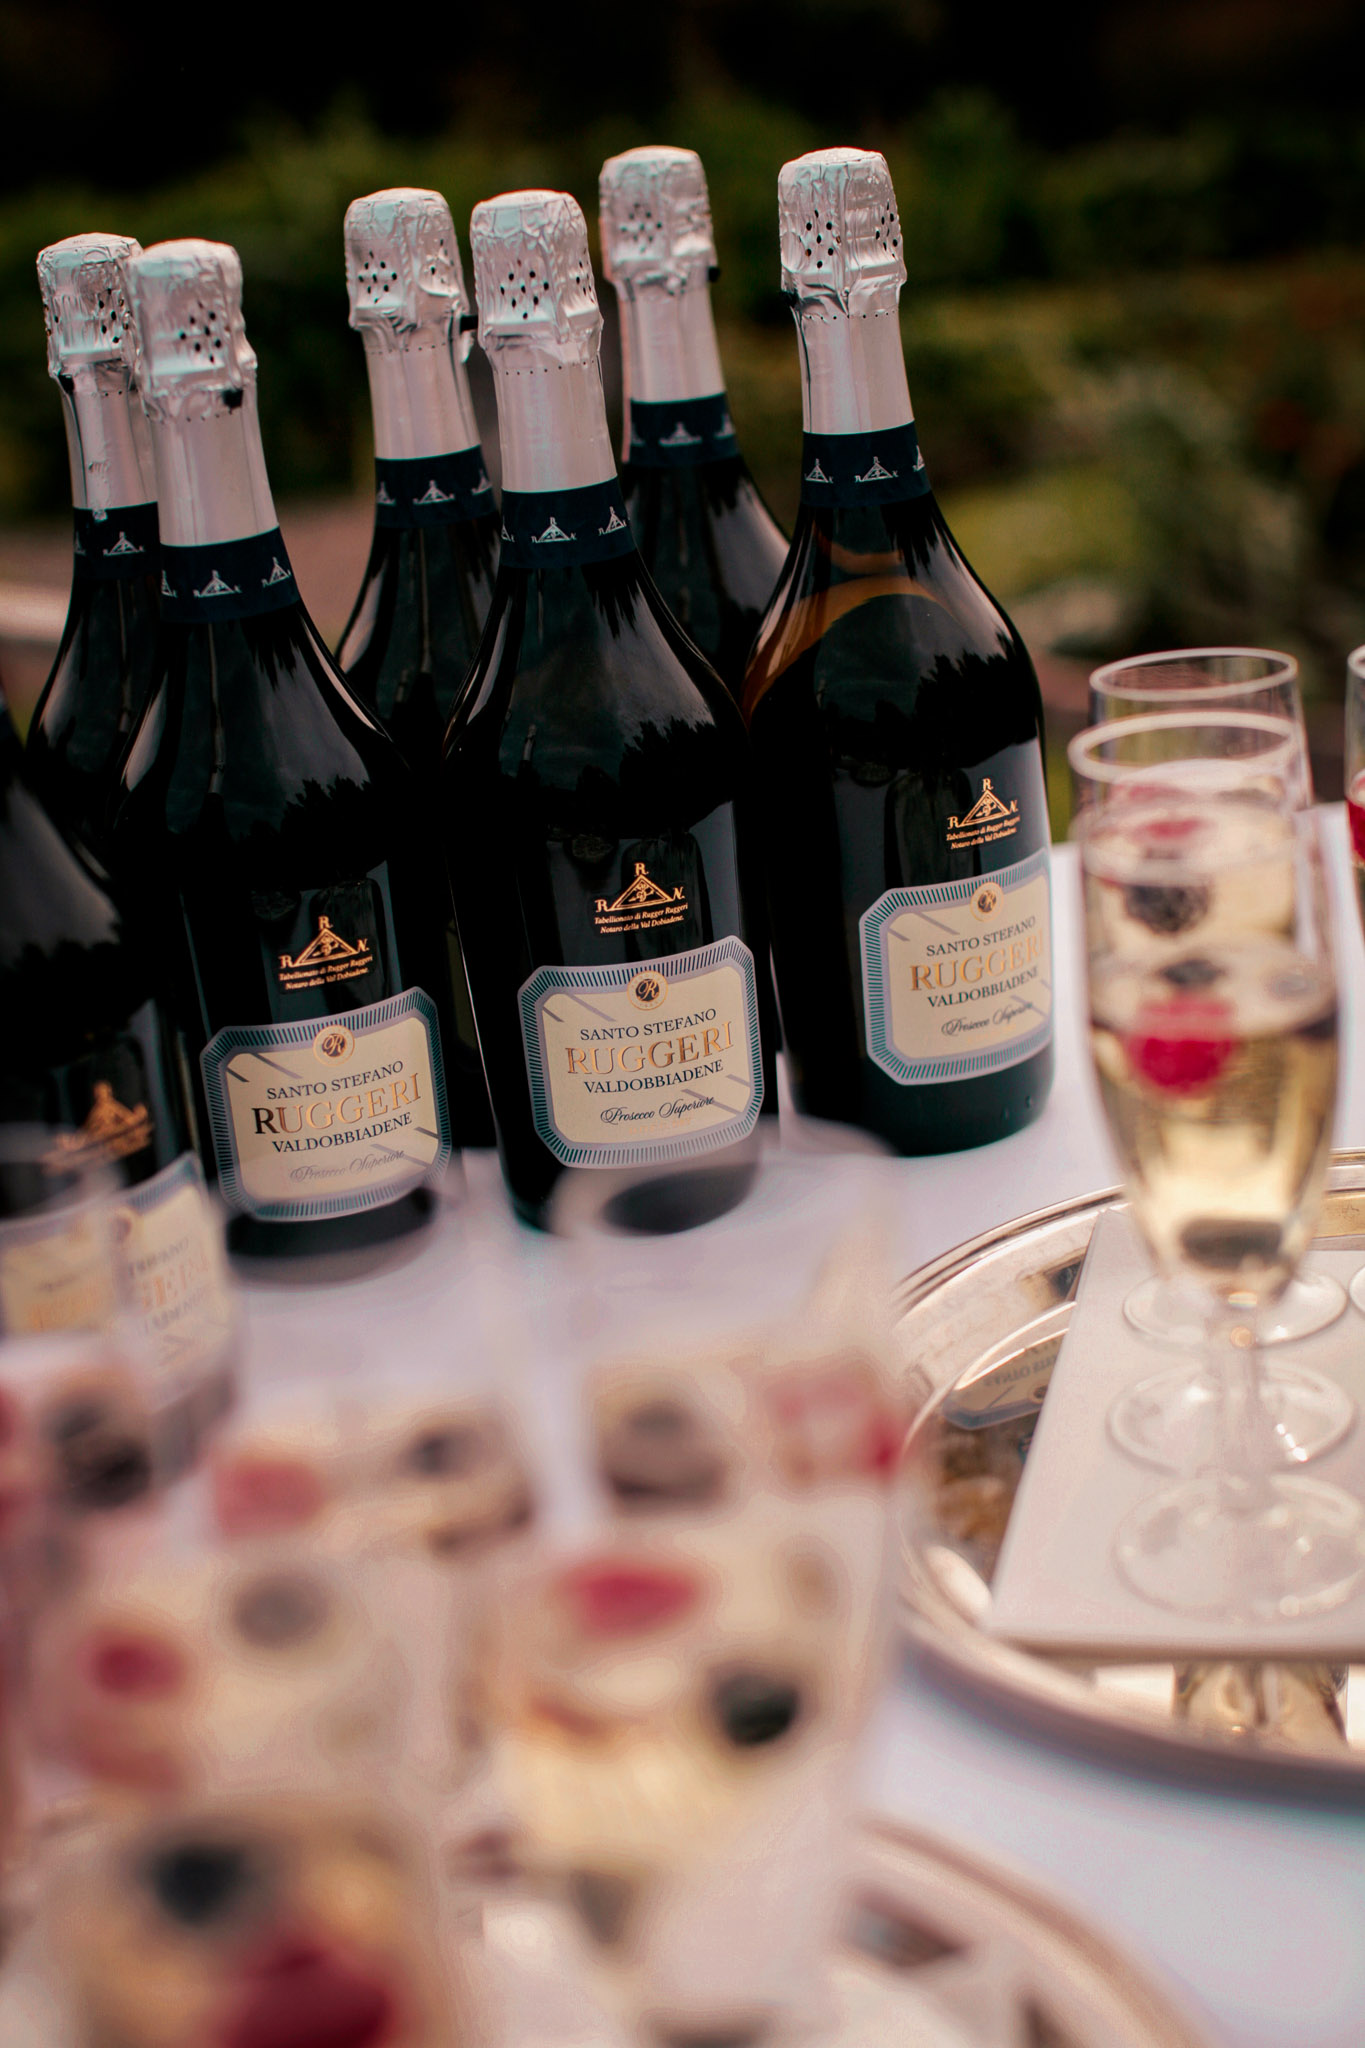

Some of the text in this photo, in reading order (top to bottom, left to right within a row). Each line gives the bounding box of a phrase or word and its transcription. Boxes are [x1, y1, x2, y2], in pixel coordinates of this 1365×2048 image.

[600, 926, 623, 934] Notaro
[642, 909, 664, 920] Rugger
[665, 903, 689, 915] Ruggeri
[926, 915, 1036, 957] SANTO STEFANO
[910, 928, 1044, 991] RUGGERI
[927, 965, 1038, 1008] VALDOBBIADENE
[580, 1008, 717, 1041] SANTO STEFANO
[941, 1016, 990, 1037] Prosecco
[565, 1021, 734, 1075] RUGGERI
[266, 1060, 404, 1100] SANTO STEFANO
[584, 1059, 724, 1094] VALDOBBIADENE
[252, 1072, 422, 1135] RUGGERI
[600, 1096, 714, 1125] Prosecco Superiore
[272, 1112, 413, 1153] VALDOBBIADENE
[290, 1164, 346, 1182] Prosecco
[350, 1150, 405, 1173] Superiore
